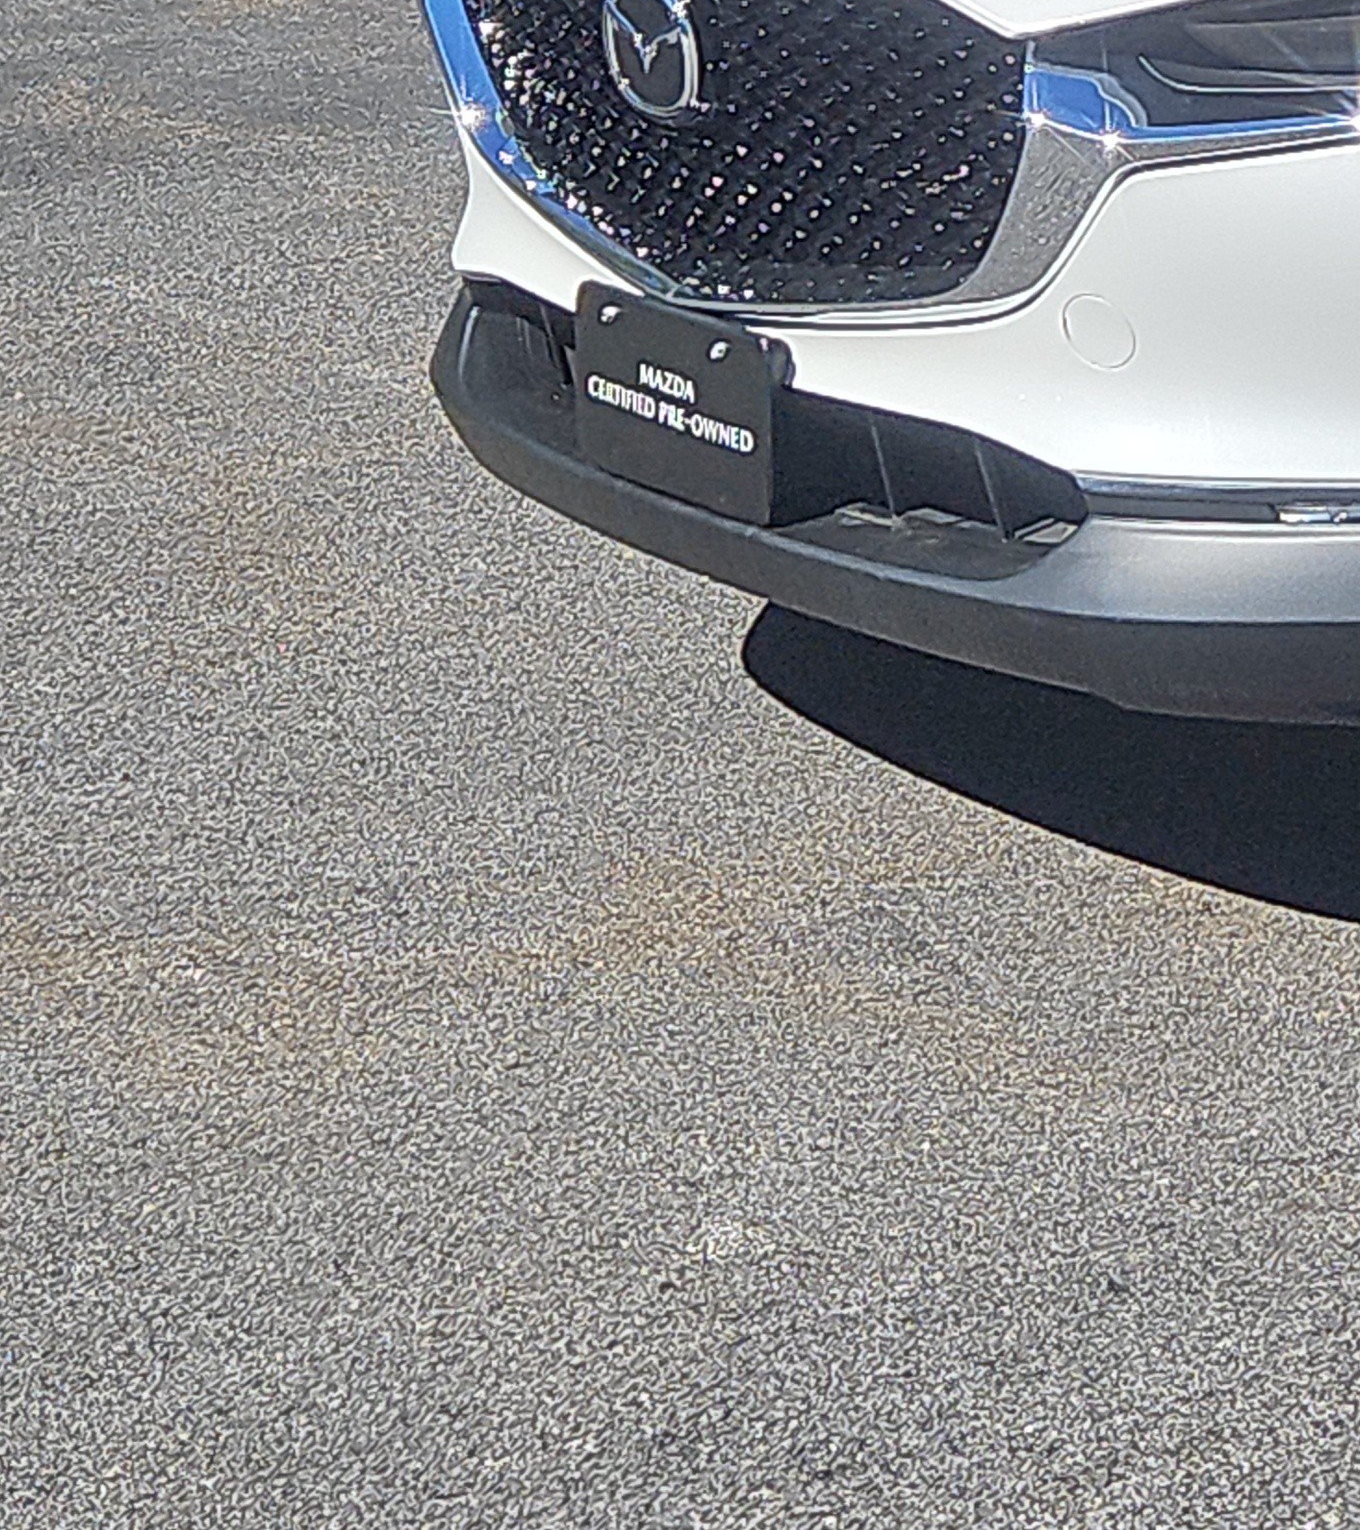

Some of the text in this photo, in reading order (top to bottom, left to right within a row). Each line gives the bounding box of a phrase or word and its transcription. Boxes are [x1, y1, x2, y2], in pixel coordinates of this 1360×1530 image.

[638, 363, 696, 404] MAZDA
[587, 375, 755, 453] CERTIFIED PRE-OWNED
